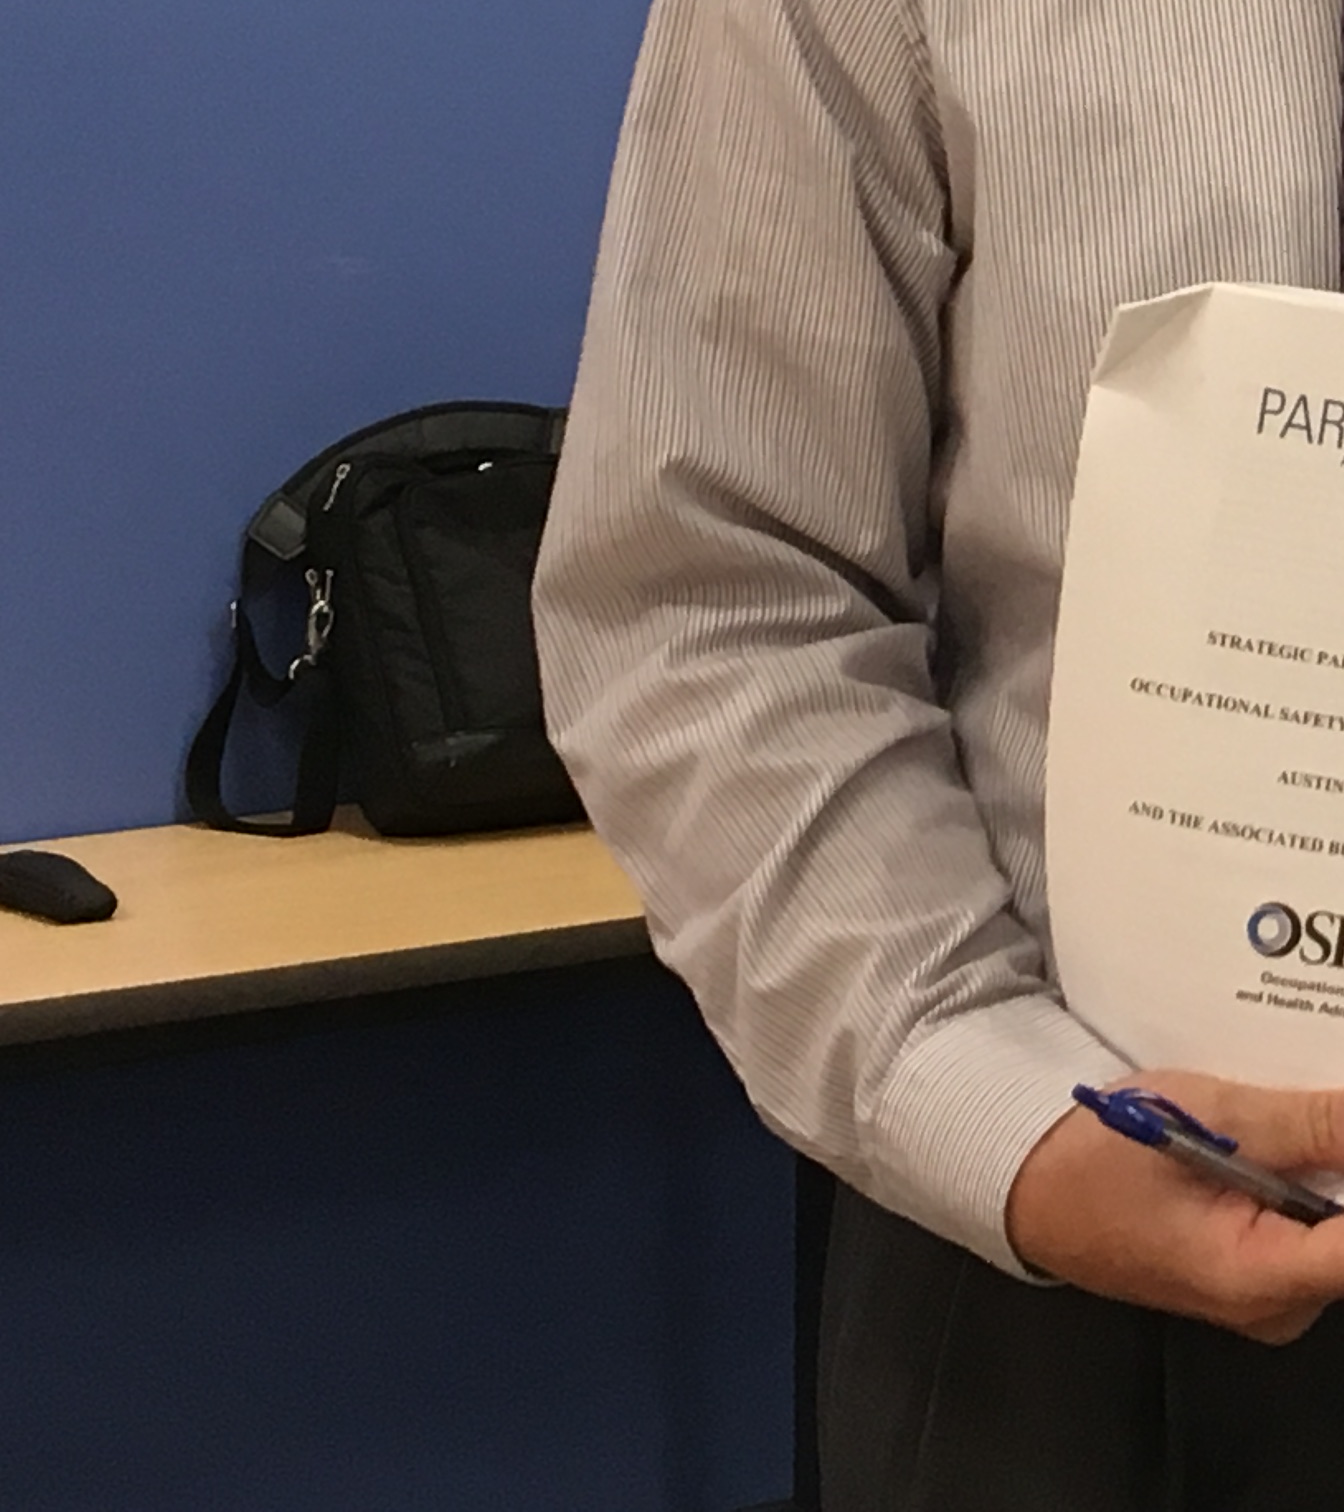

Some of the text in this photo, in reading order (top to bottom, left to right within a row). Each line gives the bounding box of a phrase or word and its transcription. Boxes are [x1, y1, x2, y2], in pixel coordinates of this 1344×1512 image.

[1207, 630, 1313, 664] STRATEGIC
[1130, 676, 1275, 719] OCCUPATIONAL
[1277, 769, 1344, 794] AUSTIN
[1128, 800, 1164, 821] AND
[1168, 809, 1204, 830] THE
[1208, 819, 1324, 853] ASSOCIATED
[1236, 988, 1264, 1003] and
[1267, 992, 1314, 1013] Health
